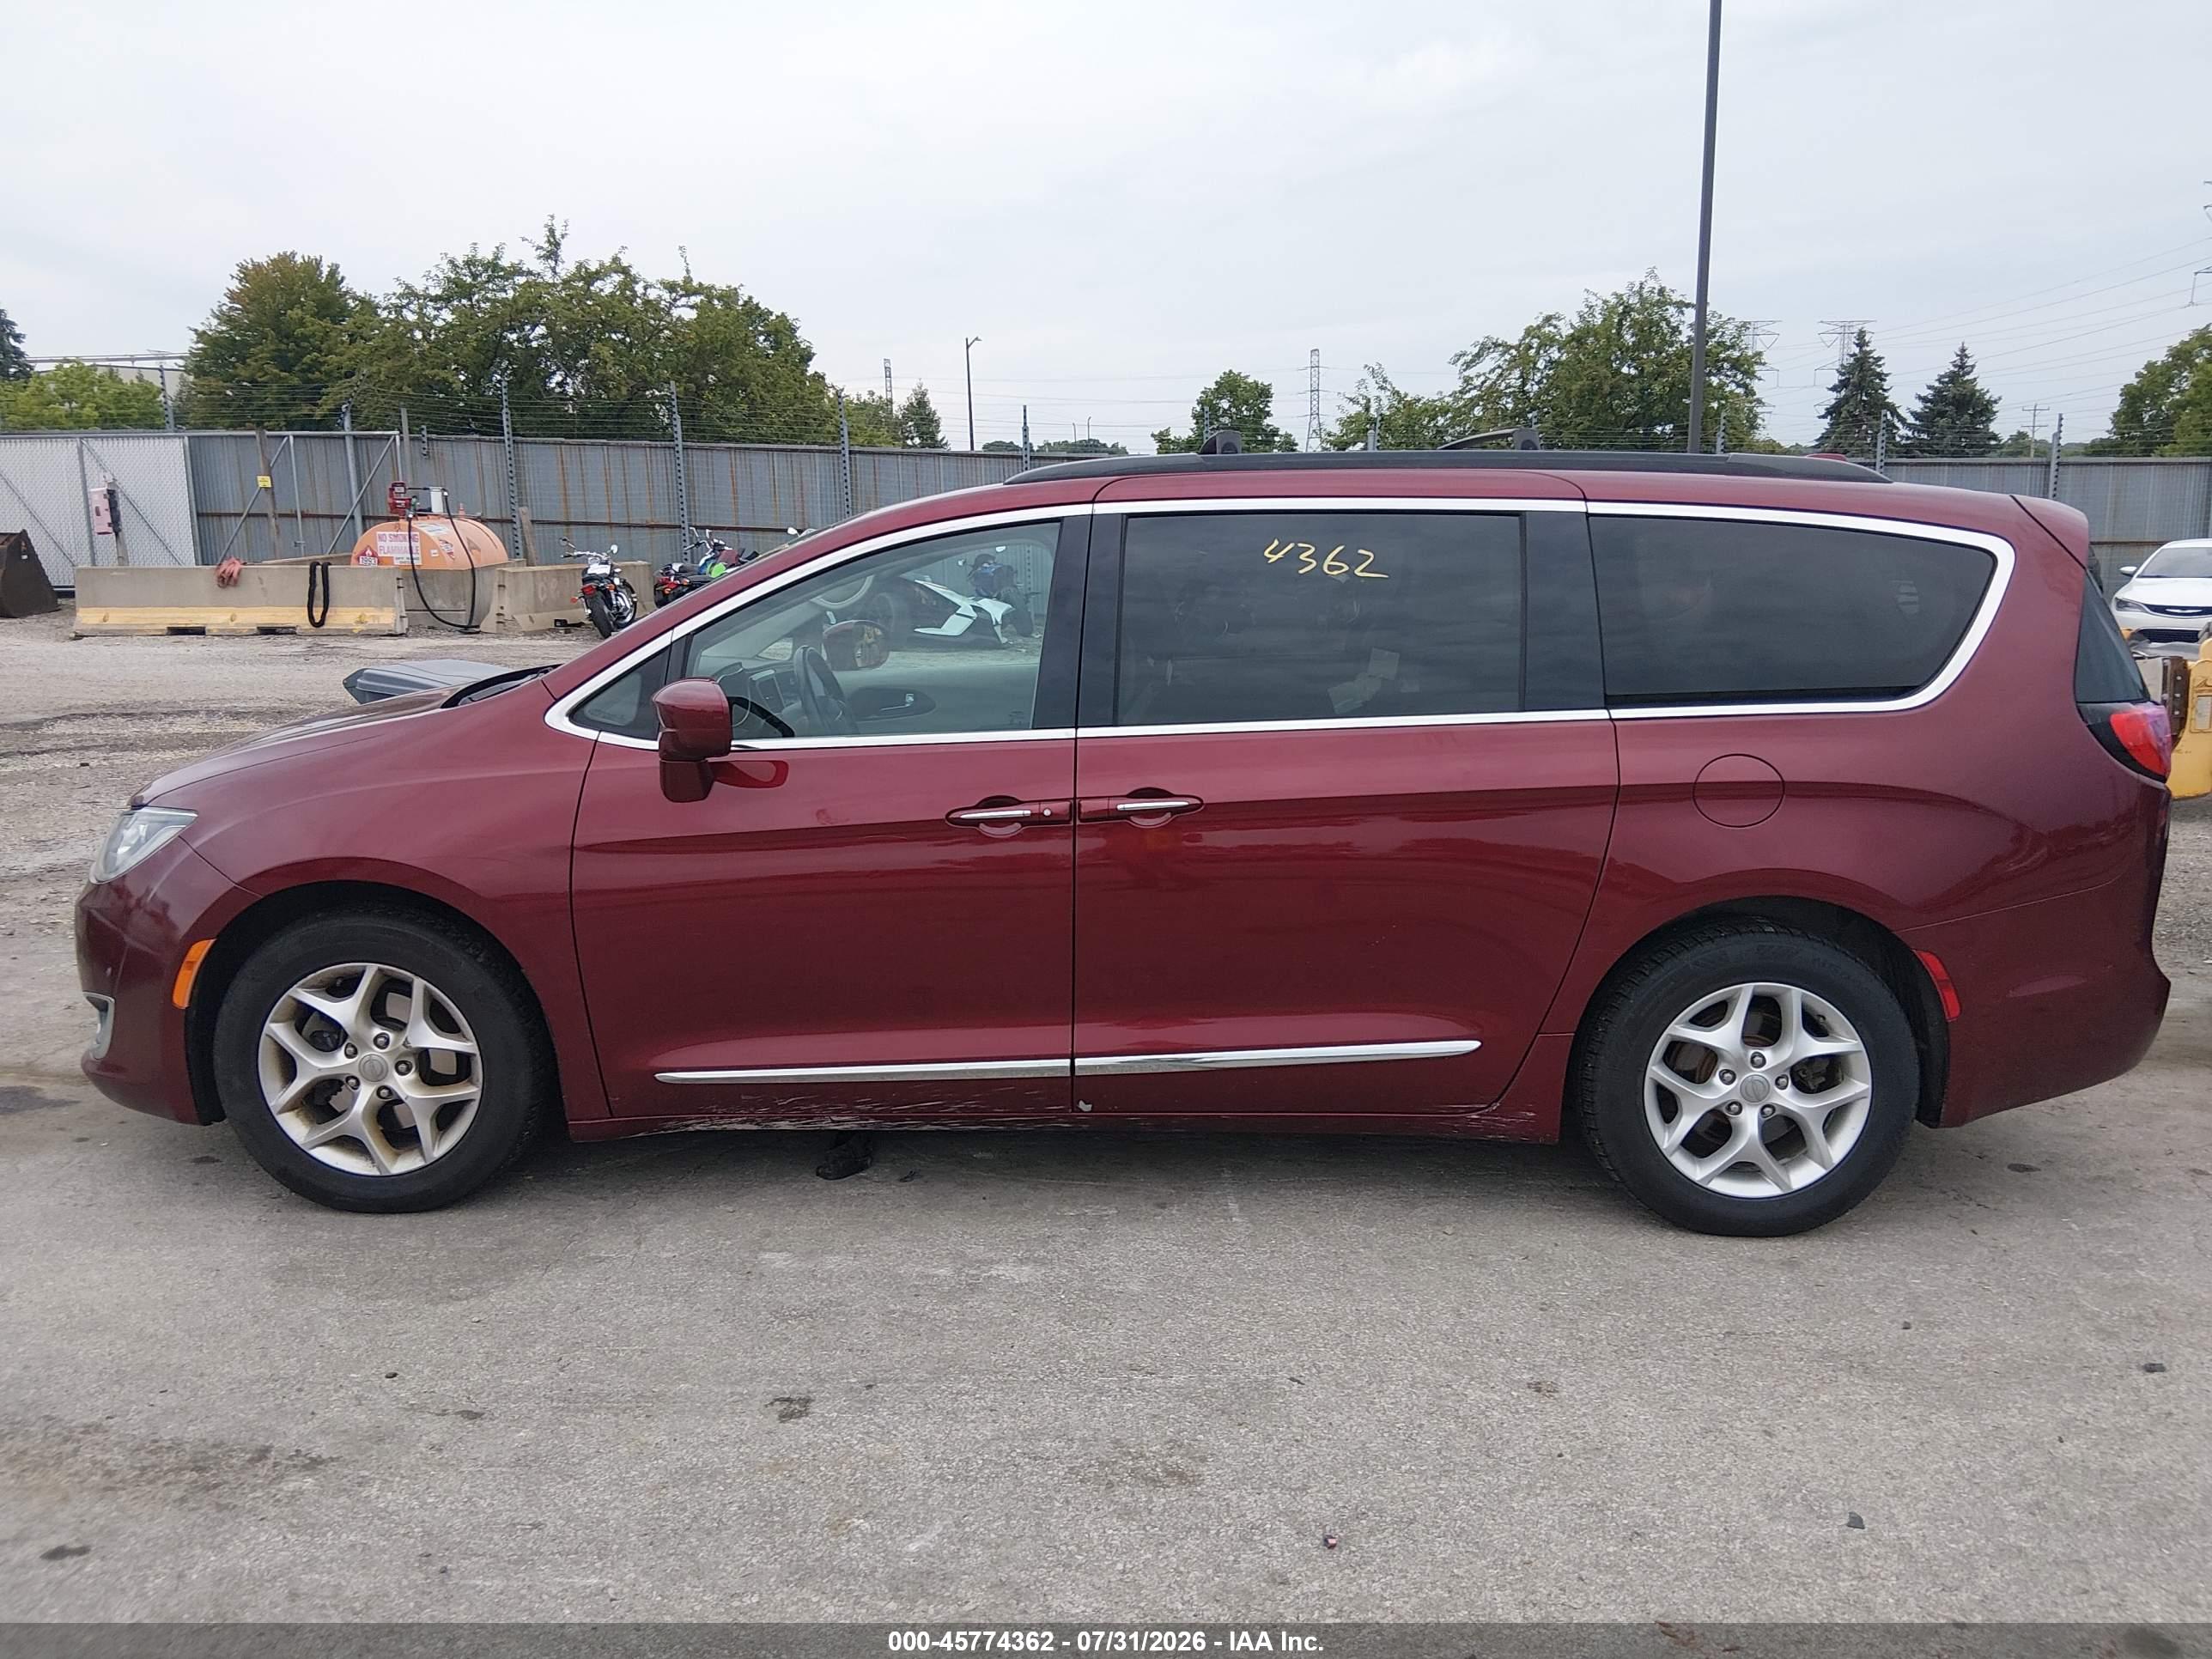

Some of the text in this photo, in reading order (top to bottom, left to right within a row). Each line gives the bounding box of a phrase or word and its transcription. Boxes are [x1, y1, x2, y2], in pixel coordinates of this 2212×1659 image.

[378, 533, 420, 543] NO SMOKNG
[379, 545, 420, 555] FLAMMALE
[1263, 538, 1389, 578] 4362
